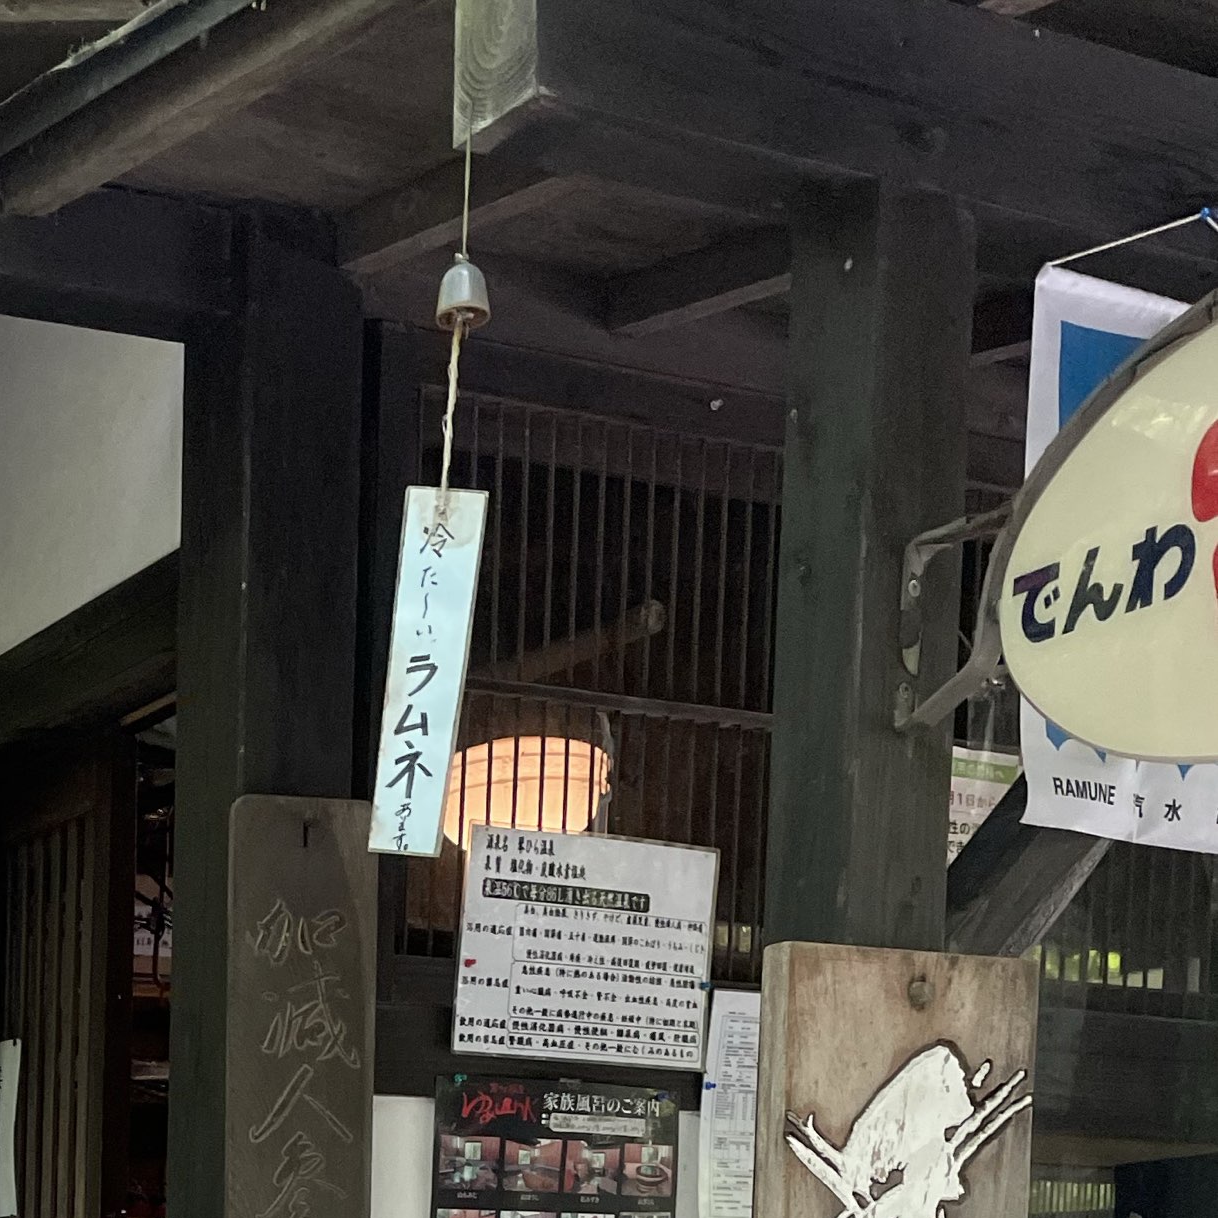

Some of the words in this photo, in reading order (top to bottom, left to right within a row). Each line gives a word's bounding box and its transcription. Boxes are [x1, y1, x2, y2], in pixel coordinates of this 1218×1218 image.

[1013, 523, 1196, 643] でんわ
[1052, 776, 1116, 805] RAMUNE
